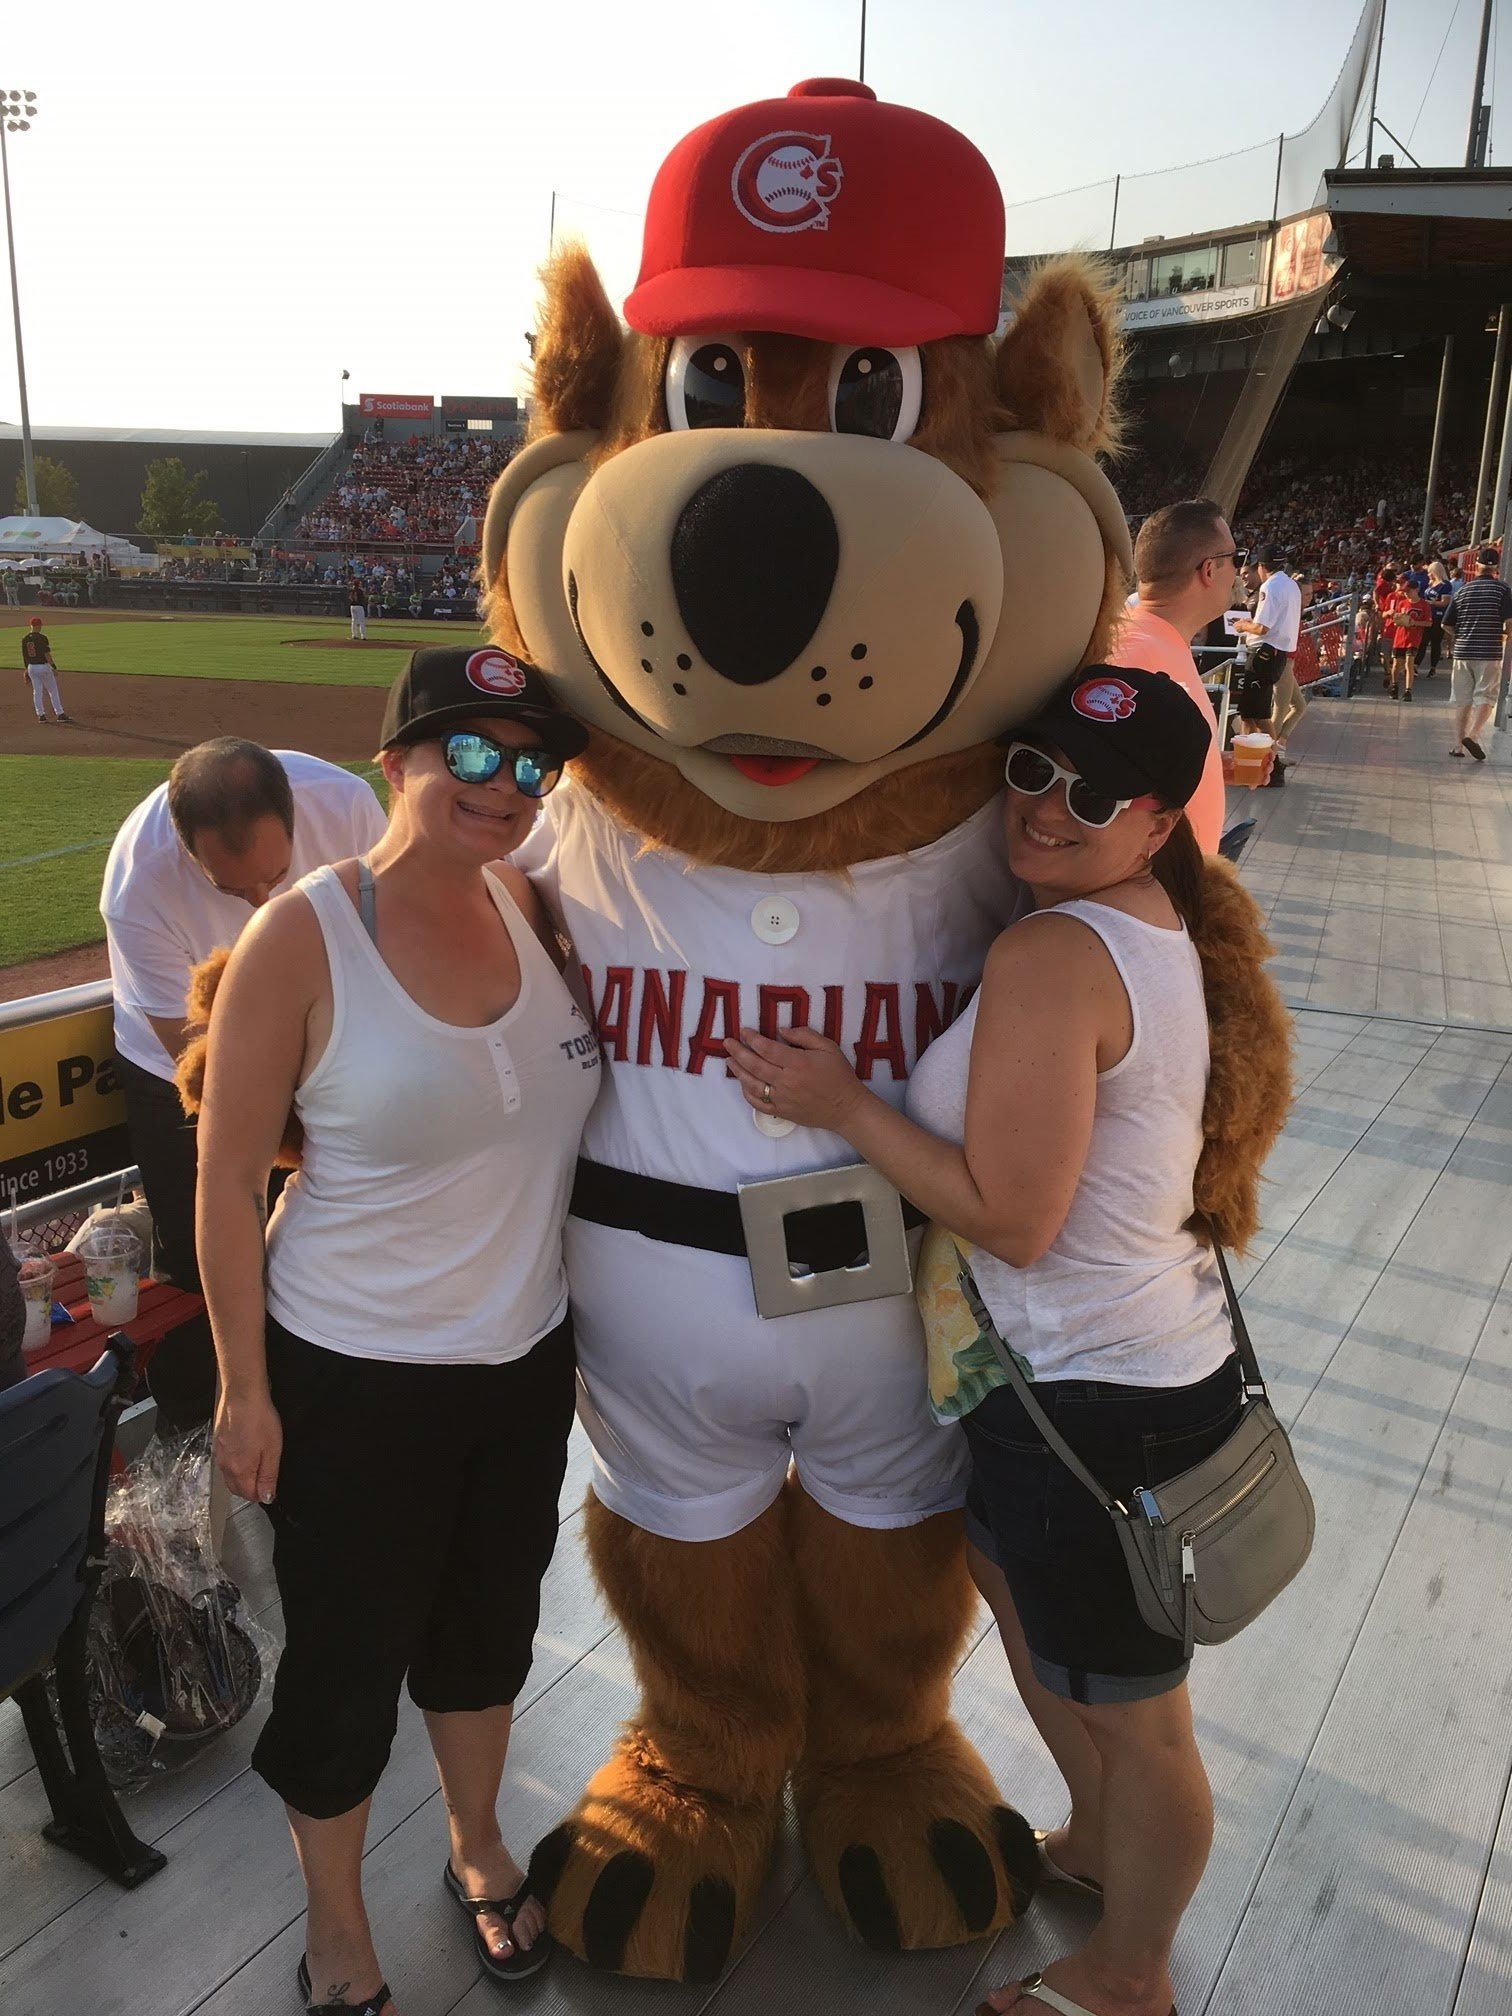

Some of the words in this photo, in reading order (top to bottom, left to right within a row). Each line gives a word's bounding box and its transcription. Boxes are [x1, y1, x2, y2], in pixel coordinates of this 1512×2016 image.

[1125, 310, 1148, 321] VOICE
[1150, 309, 1161, 318] OF
[1162, 303, 1213, 318] VANCOUVER
[1214, 297, 1249, 311] SPORTS
[376, 401, 429, 411] Scotiabank
[44, 1149, 89, 1181] 1933
